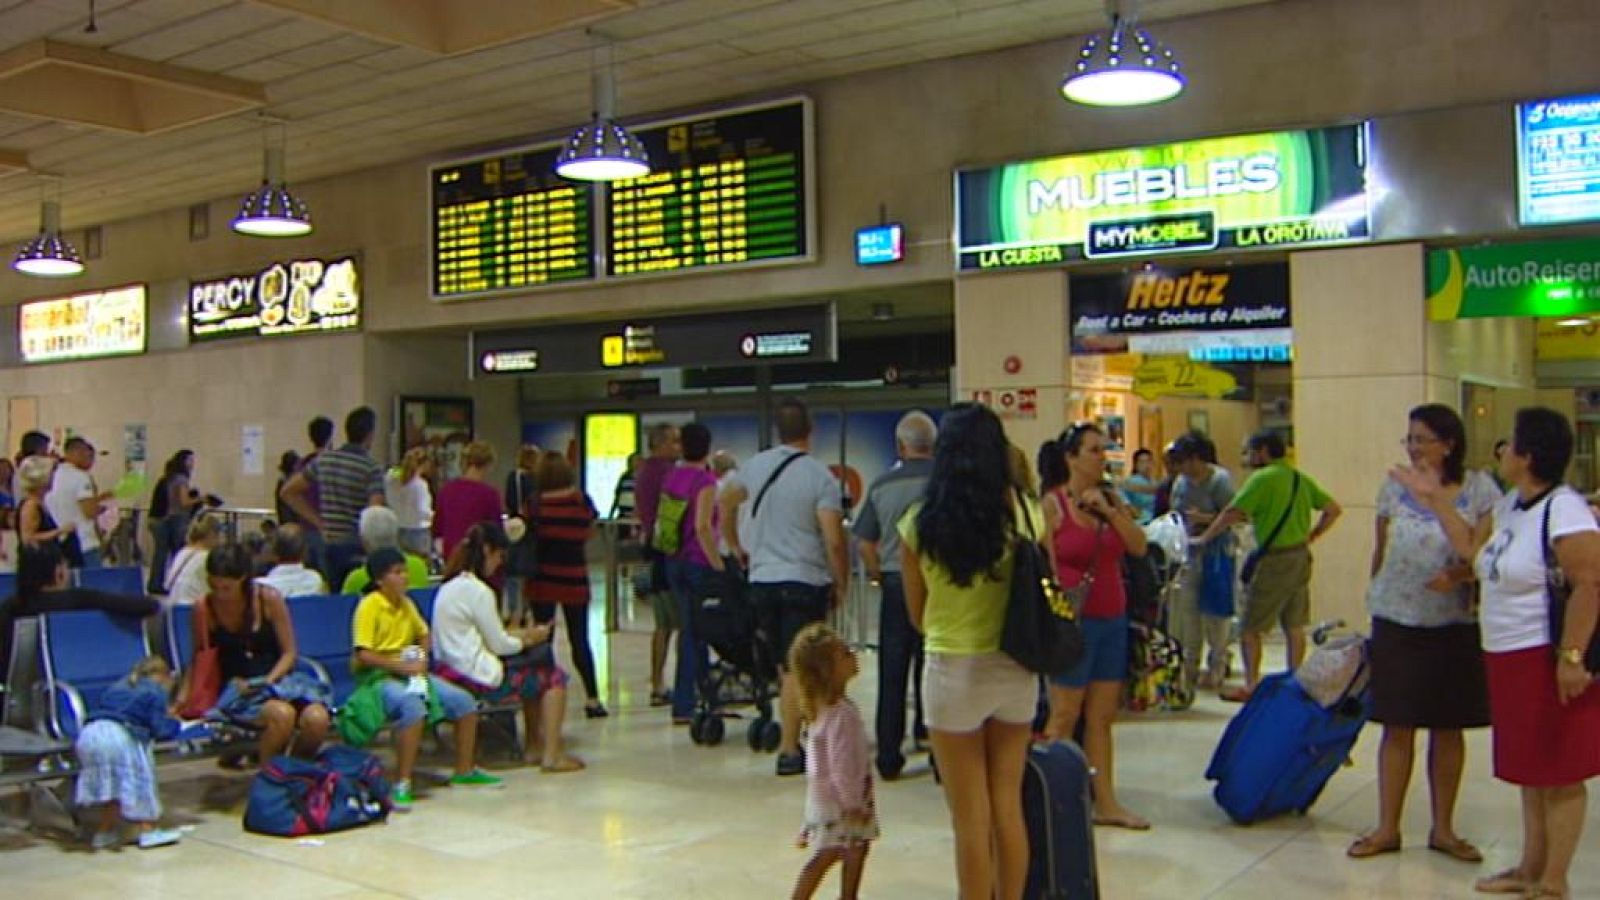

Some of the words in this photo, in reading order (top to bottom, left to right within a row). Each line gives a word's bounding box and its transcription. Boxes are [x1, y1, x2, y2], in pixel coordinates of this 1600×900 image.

[1028, 153, 1281, 215] MUEBLES
[1094, 220, 1207, 248] MYMOBEL
[1236, 228, 1261, 246] LA
[1264, 219, 1349, 243] OROTAVA
[980, 251, 1000, 267] LA
[1002, 246, 1062, 264] CUESTA
[193, 278, 256, 311] PERCY
[1126, 271, 1230, 309] Hertz
[1122, 312, 1146, 328] Car
[1157, 310, 1207, 326] Coches
[1210, 308, 1228, 323] de
[1230, 305, 1287, 324] Alquiler
